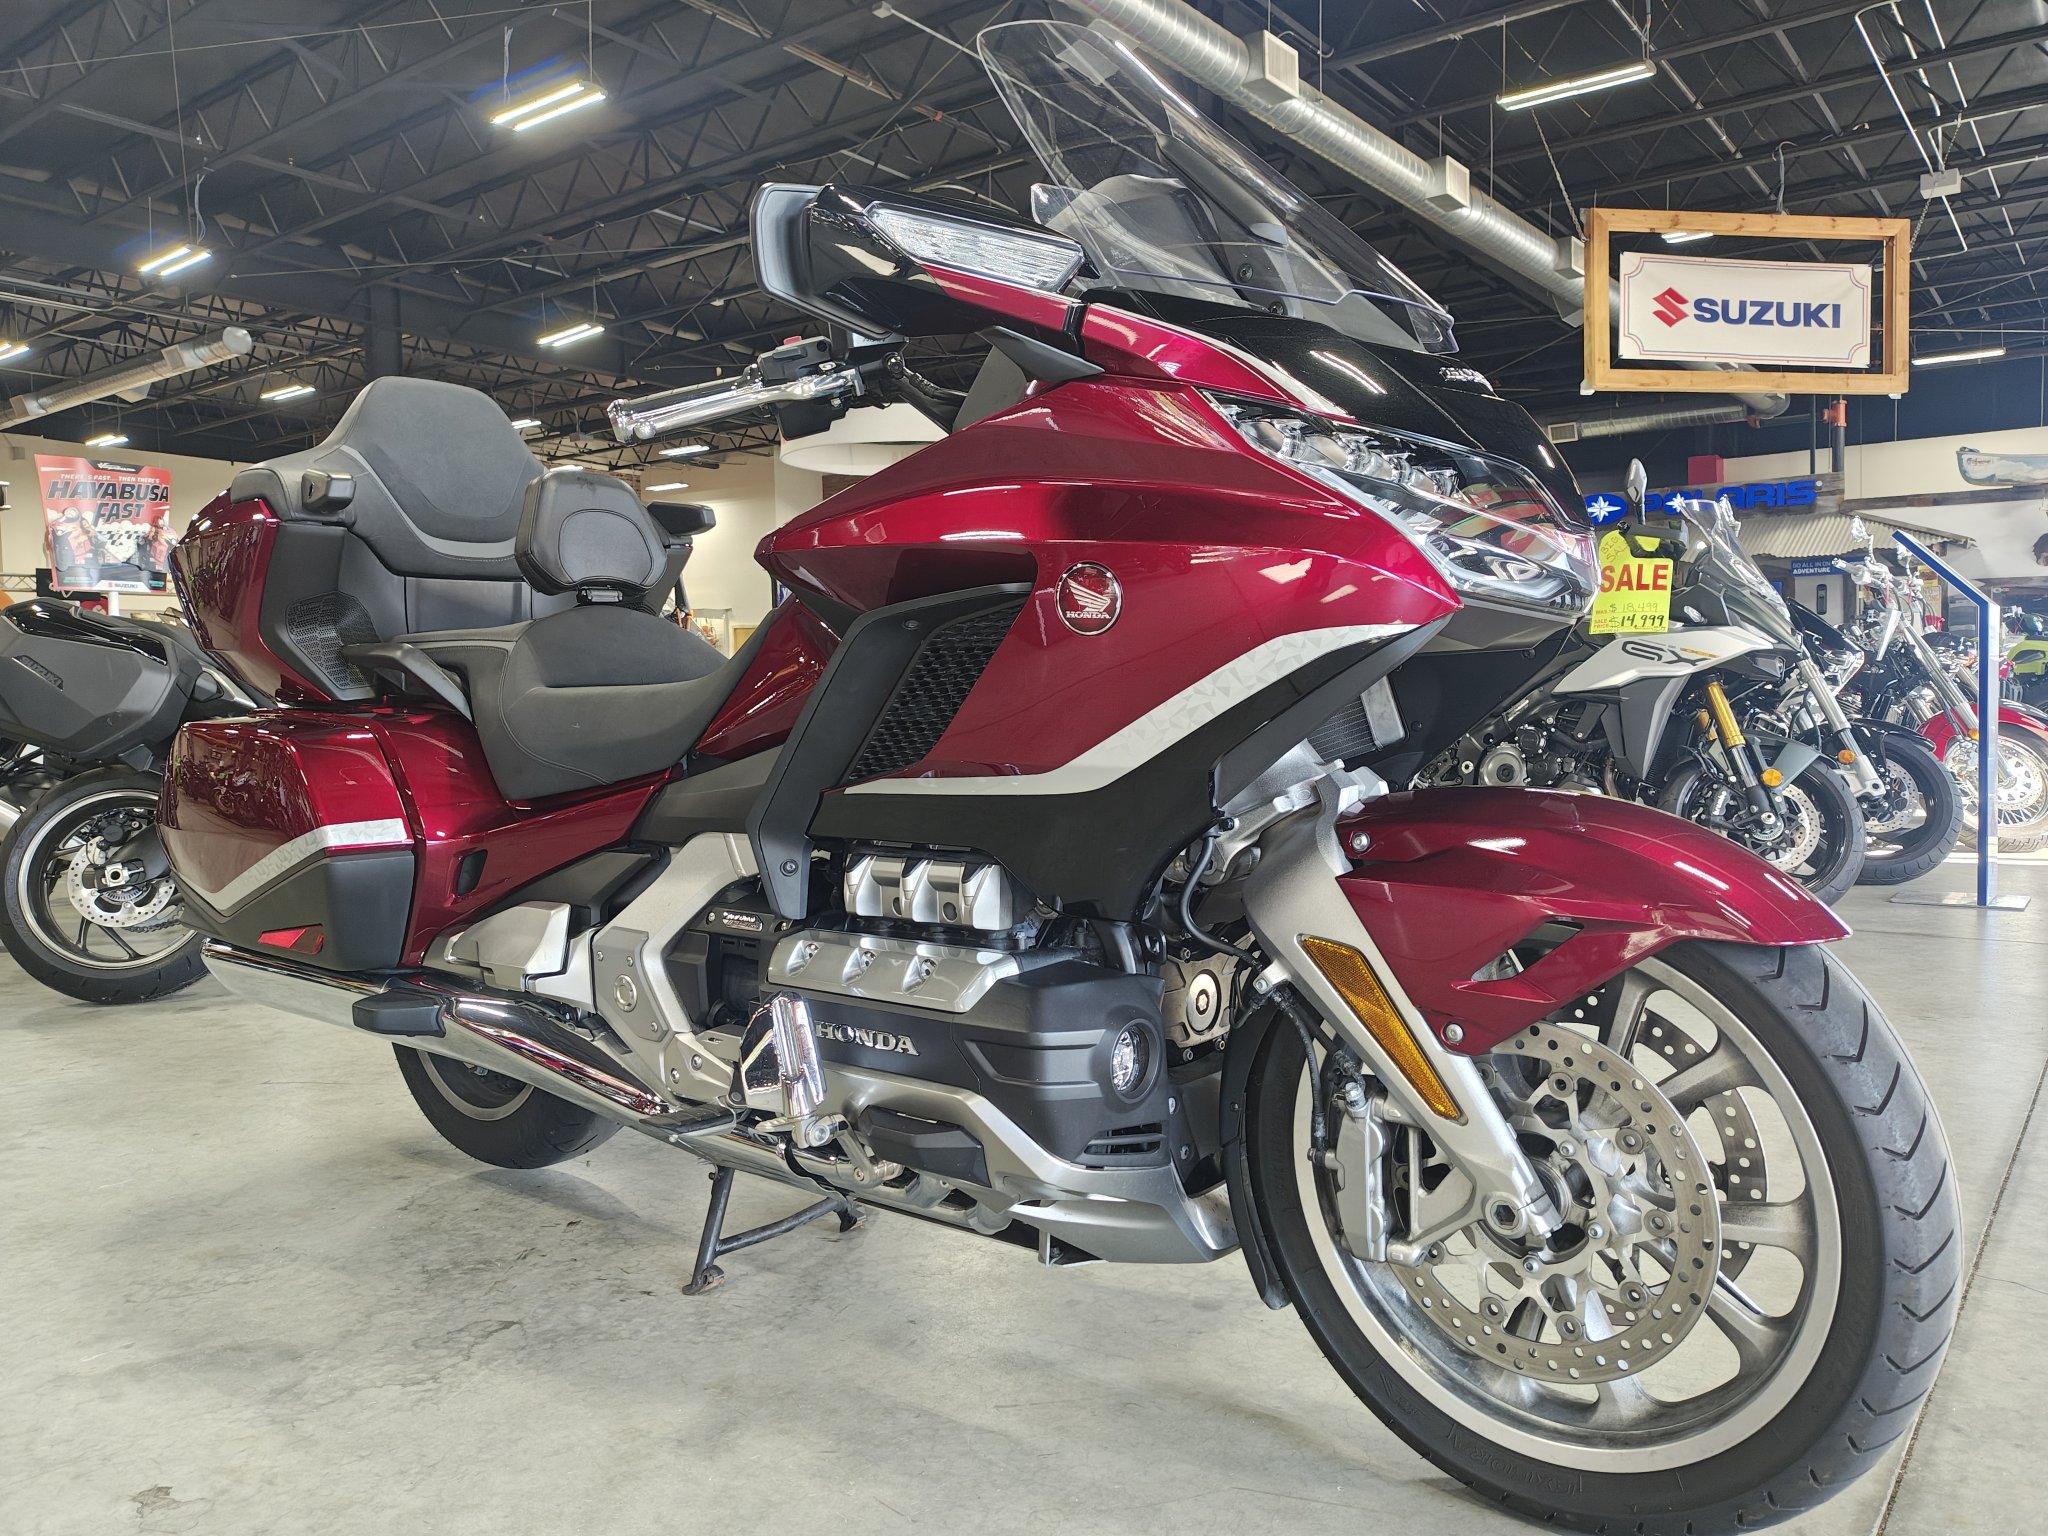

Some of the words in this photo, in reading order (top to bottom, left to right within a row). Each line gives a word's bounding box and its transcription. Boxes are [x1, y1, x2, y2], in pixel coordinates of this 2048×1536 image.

[1693, 297, 1841, 329] SUZUKI
[47, 480, 169, 502] HAYABUSA
[92, 502, 145, 527] FAST
[1600, 564, 1669, 592] SALE
[1792, 567, 1831, 575] ADVENTURE
[1065, 611, 1112, 619] HONDA
[814, 1020, 920, 1056] HONDA
